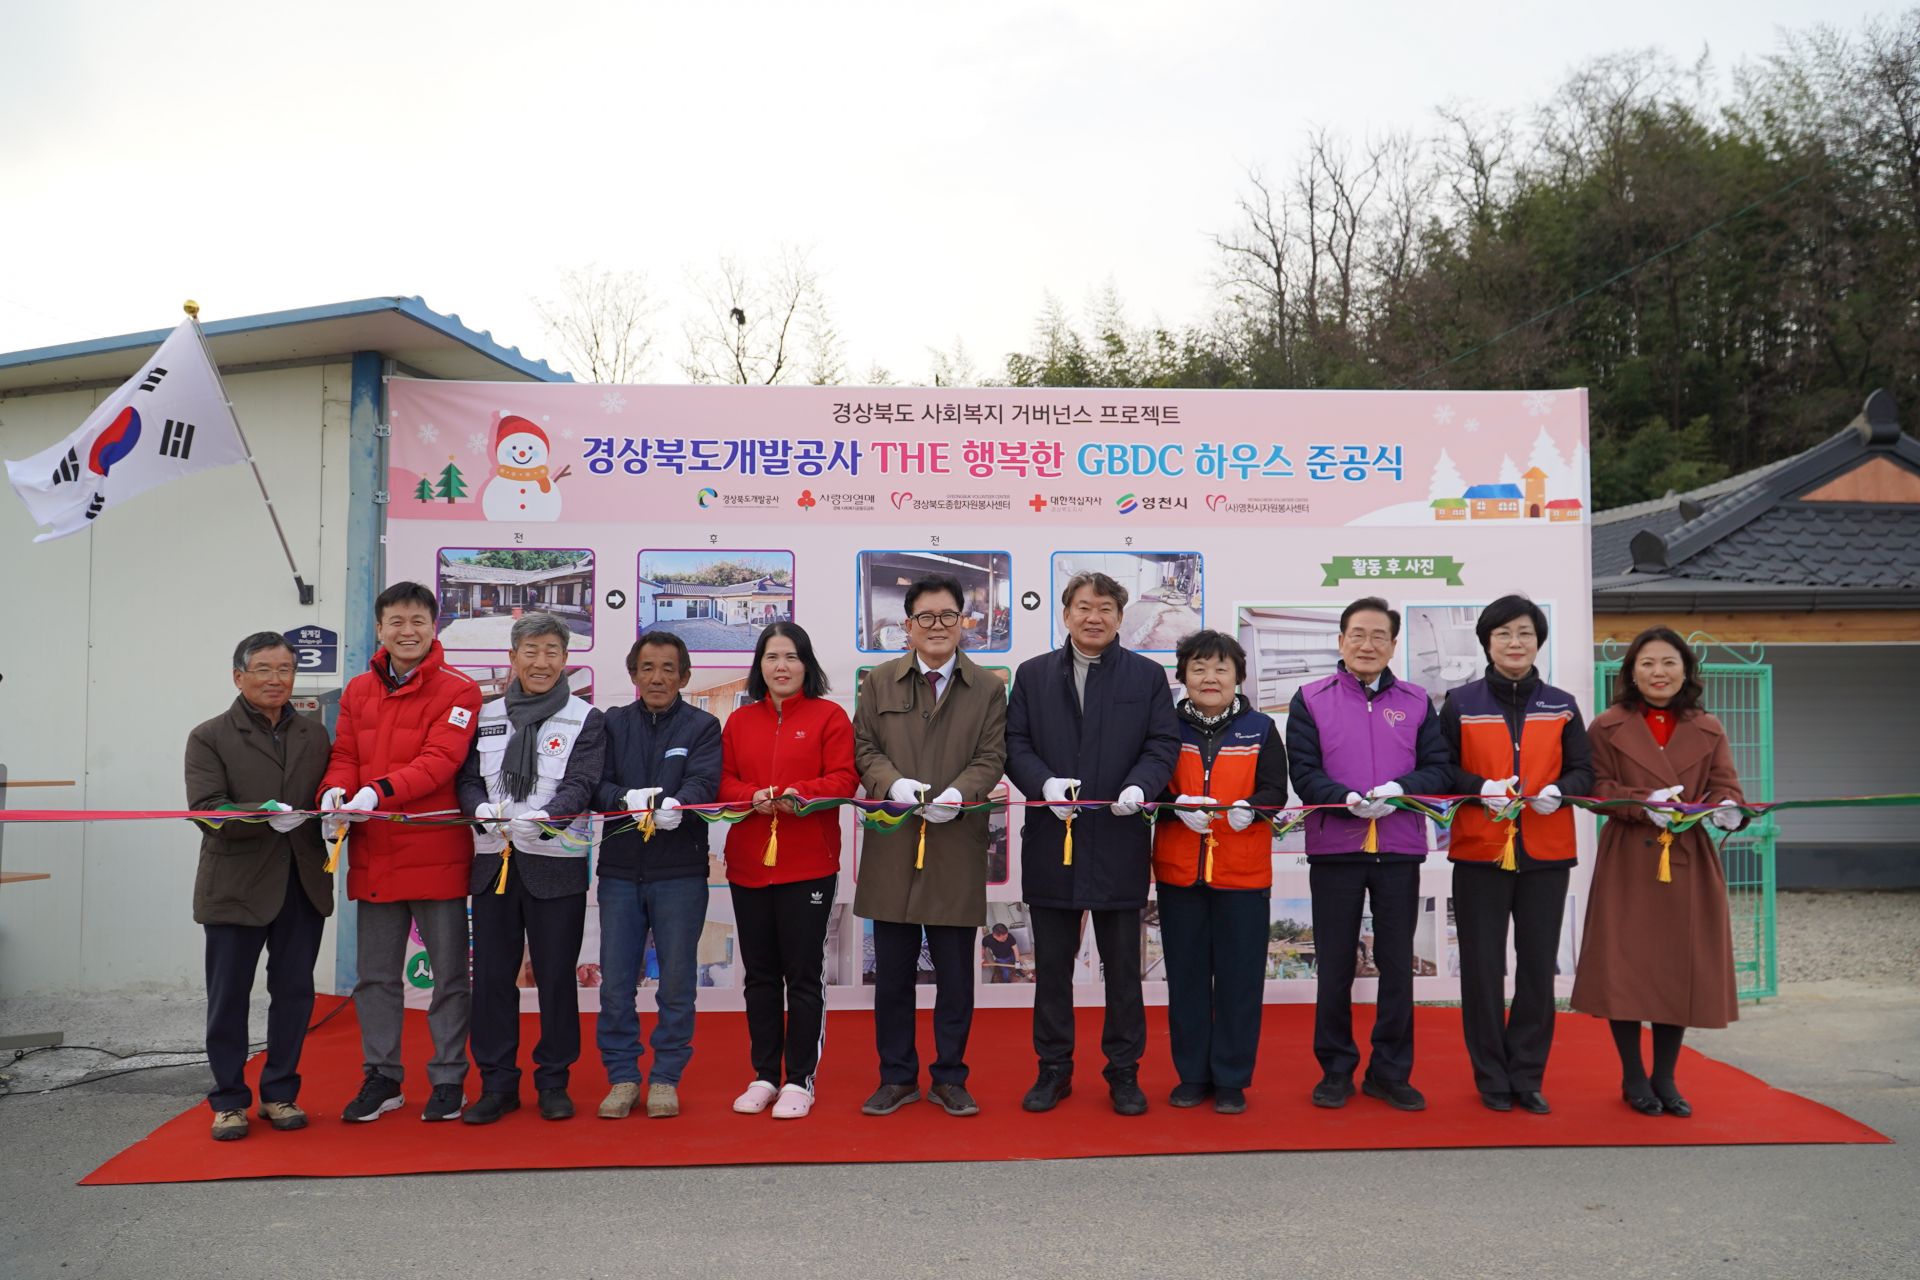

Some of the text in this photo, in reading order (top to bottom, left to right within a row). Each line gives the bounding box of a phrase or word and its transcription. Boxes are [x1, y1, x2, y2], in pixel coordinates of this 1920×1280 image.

[832, 402, 1181, 427] 경상북도 사회복지 거버넌스 프로젝트
[583, 437, 1403, 482] 경상북도개발공사 THE 행복한 GBDC 하우스 준공식
[722, 494, 780, 505] 경상북도개발공사
[818, 493, 876, 506] 사랑의열매
[913, 499, 1011, 511] 경상북도종합자원봉사센터
[1050, 495, 1103, 506] 대한적십자사
[1141, 496, 1189, 511] 영천시
[1225, 503, 1310, 513] (사)영천시자원봉사센터
[513, 532, 524, 544] 전
[709, 533, 718, 545] 후
[930, 535, 940, 547] 전
[1124, 536, 1134, 547] 후
[1352, 558, 1434, 576] 활동 후 사진
[297, 648, 322, 668] 3
